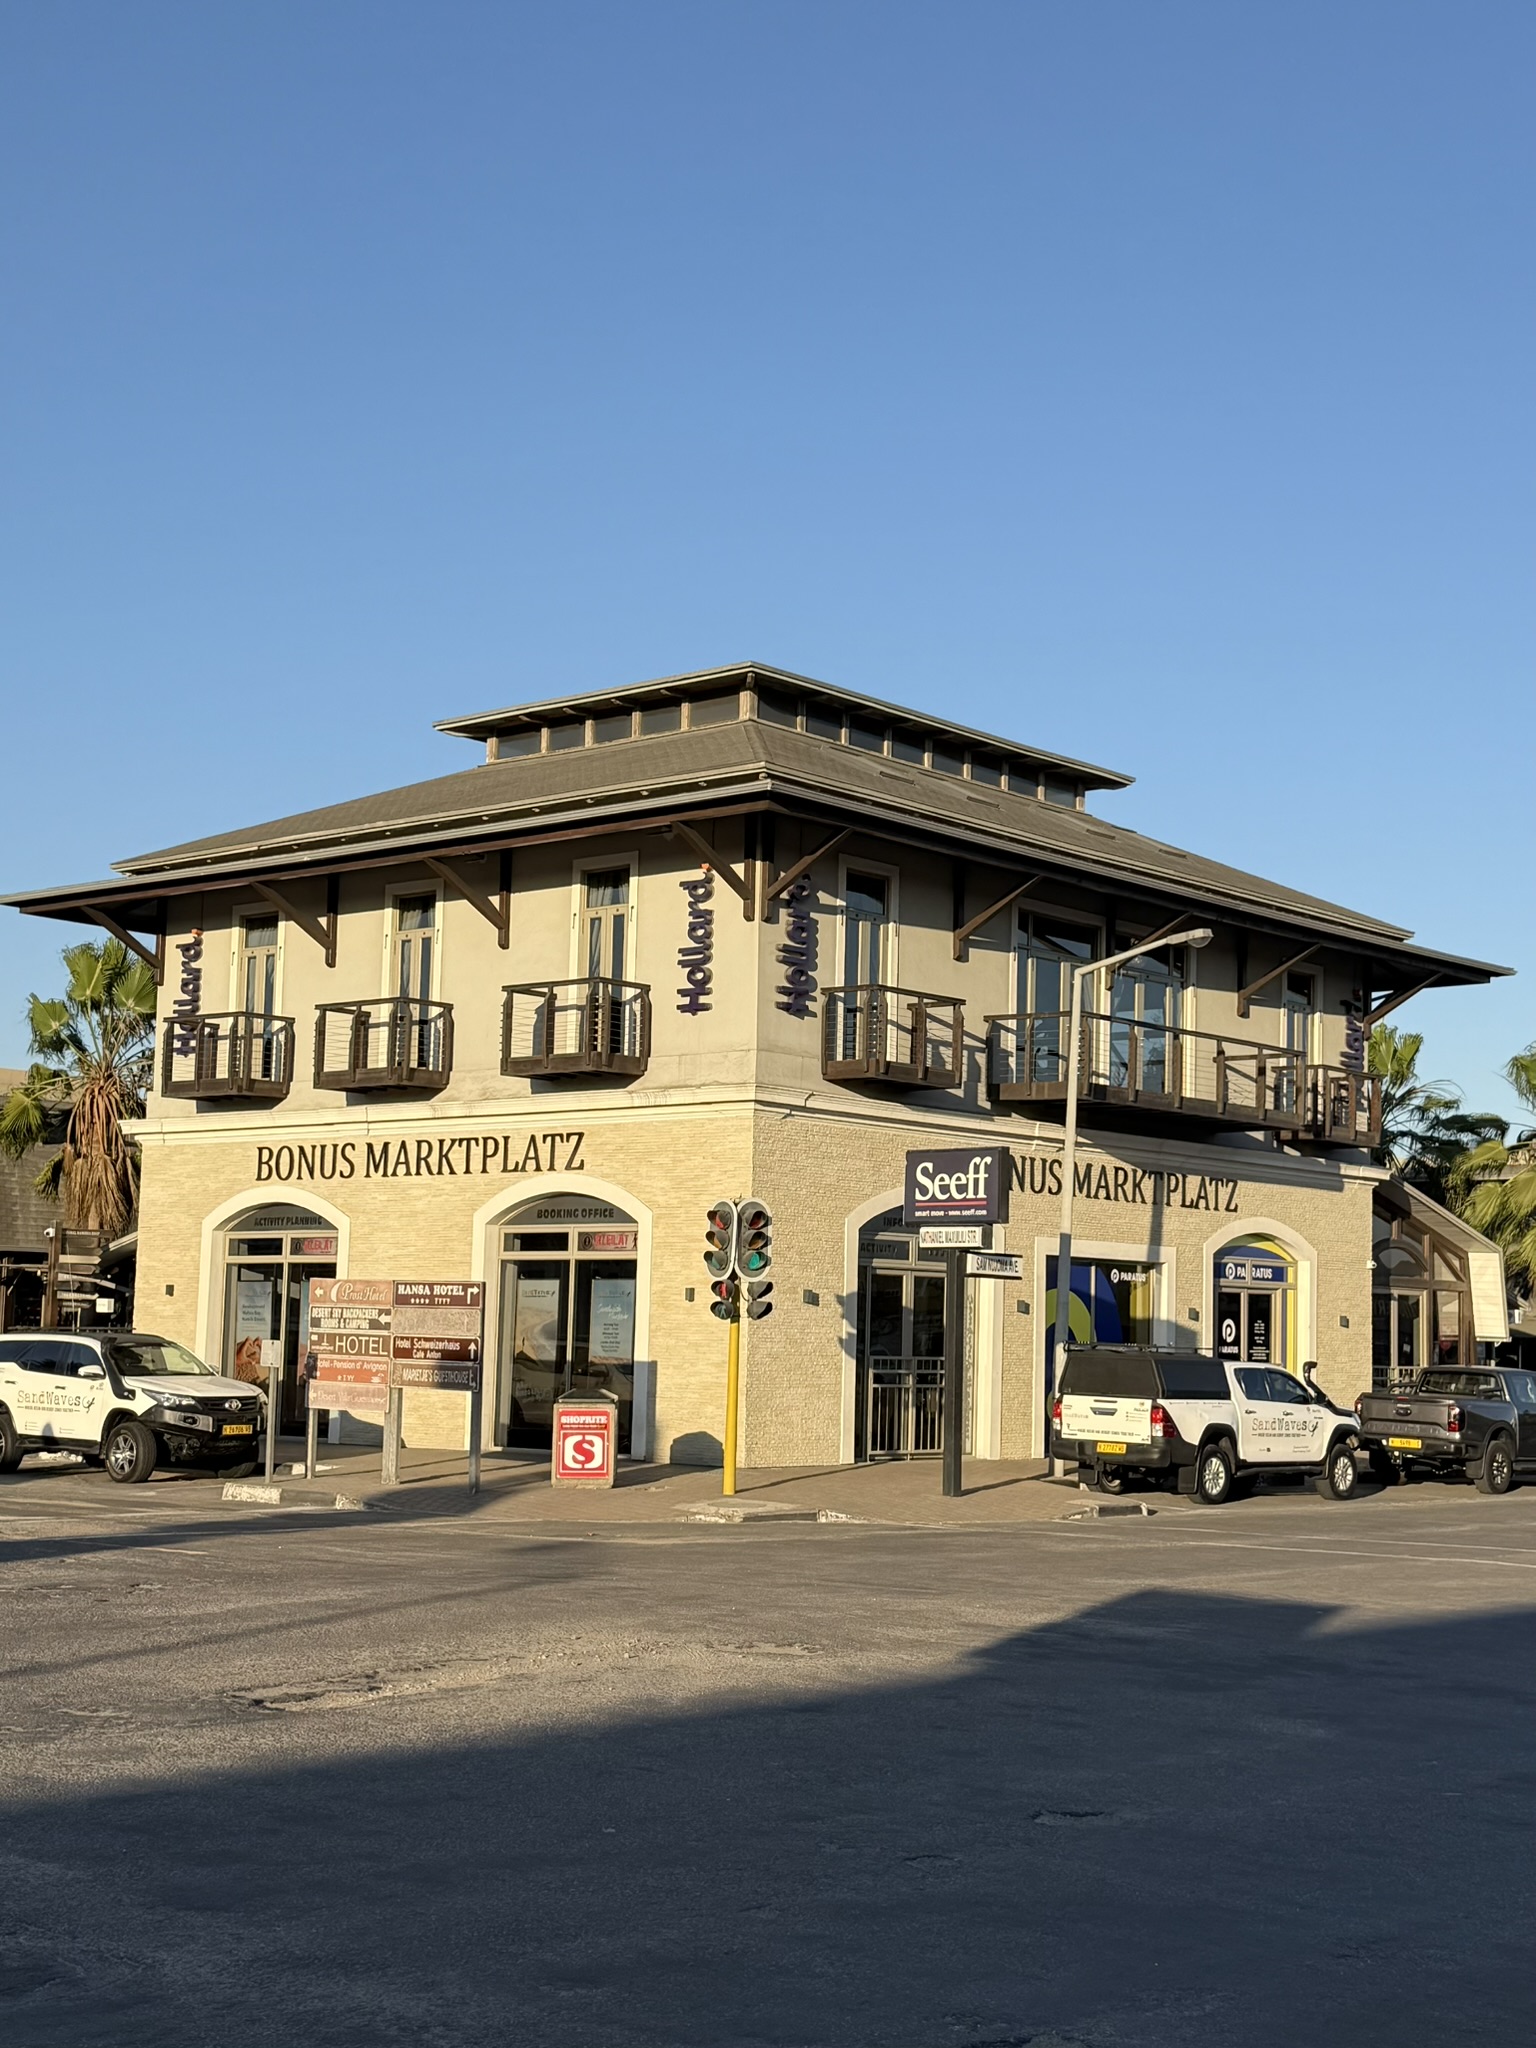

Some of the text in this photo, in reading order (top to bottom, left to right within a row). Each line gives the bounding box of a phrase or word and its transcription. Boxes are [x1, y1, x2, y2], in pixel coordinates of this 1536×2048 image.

[255, 1132, 585, 1181] BONUS MARKTPLATZ
[915, 1156, 992, 1201] Seeff
[1009, 1154, 1238, 1213] NUS MARKTPLATZ
[537, 1207, 614, 1219] BOOKING OFFICE
[948, 1208, 987, 1216] www.seeff.com
[254, 1216, 322, 1227] ACTIVITY PLANNING
[883, 1216, 903, 1227] INFO
[860, 1242, 897, 1254] ACTIVITY
[1120, 1271, 1146, 1281] PARATUS
[1237, 1266, 1272, 1279] PARATUS
[398, 1284, 464, 1296] HANSA HOTEL
[312, 1307, 331, 1318] DESERT
[335, 1335, 388, 1355] HOTEL
[395, 1338, 461, 1351] Hotel Schweizerhaus
[426, 1350, 442, 1359] Anton
[17, 1390, 81, 1406] SandWaves
[561, 1415, 608, 1424] SHOPRITE
[1252, 1418, 1307, 1431] SandWaves
